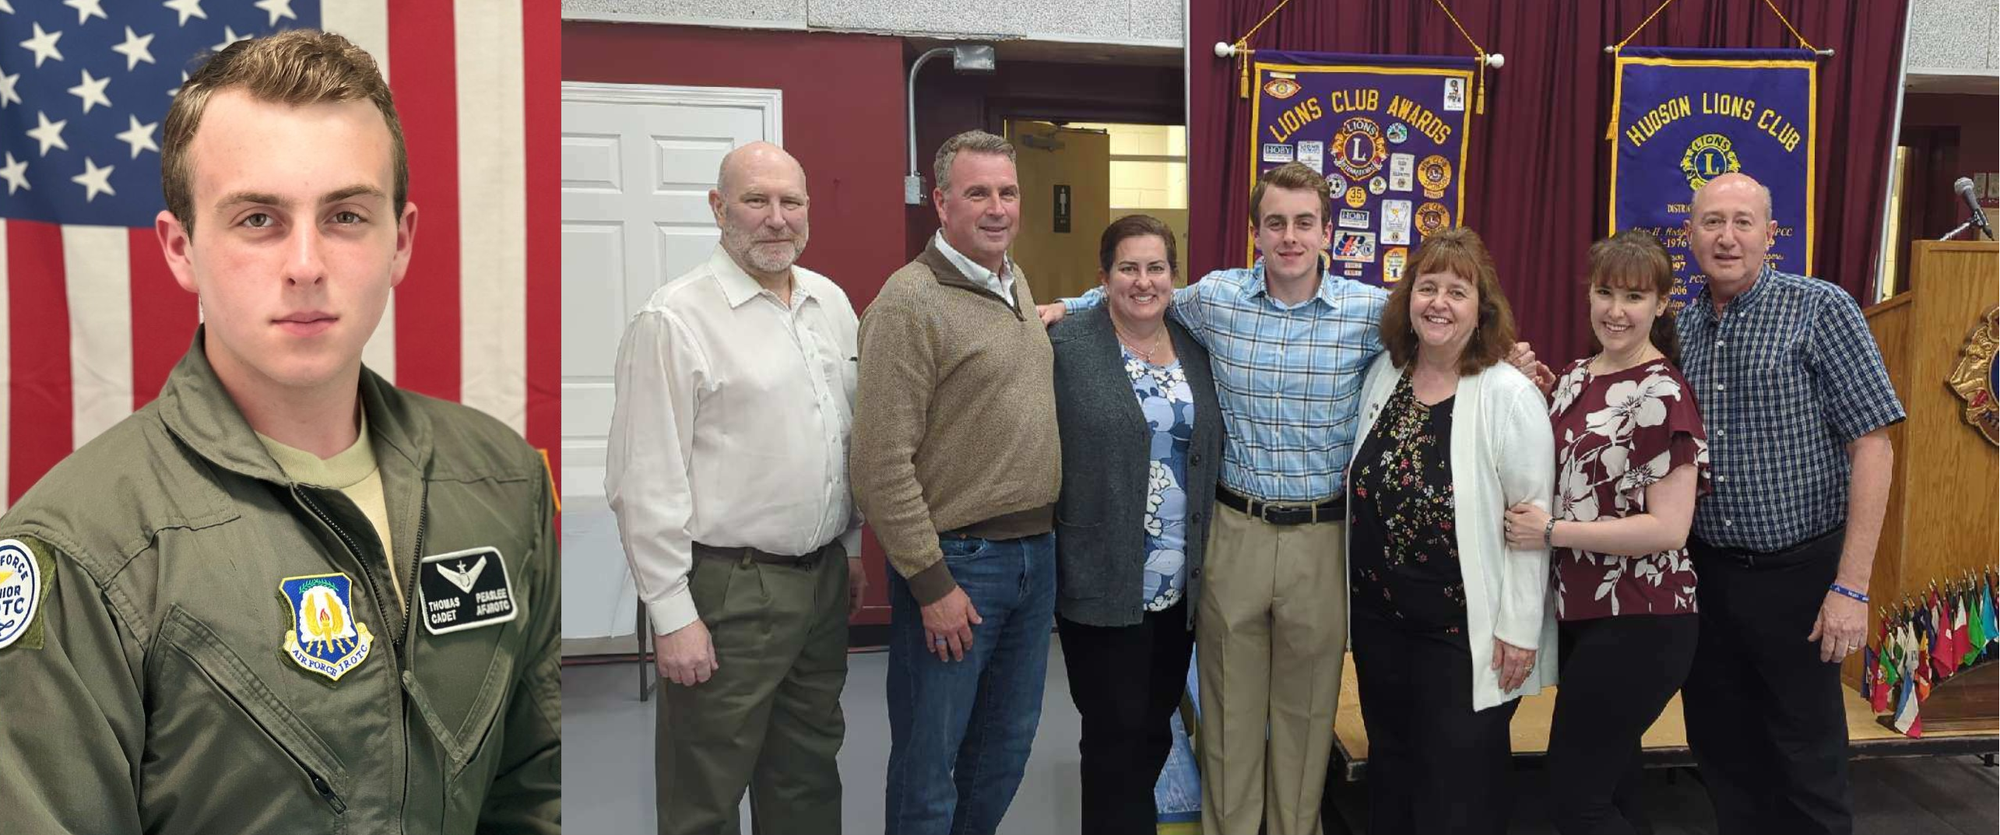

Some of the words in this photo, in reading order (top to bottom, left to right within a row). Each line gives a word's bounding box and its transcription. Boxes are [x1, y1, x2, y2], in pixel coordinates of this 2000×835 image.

[1269, 97, 1322, 143] LIONS
[1331, 89, 1379, 114] CLUB
[1387, 95, 1451, 145] AWARDS
[1626, 95, 1692, 147] HUDSON
[1702, 92, 1756, 121] LIONS
[1757, 109, 1801, 152] CLUB
[1346, 120, 1377, 136] LIONS
[1352, 138, 1366, 162] L
[1695, 135, 1731, 150] LIONS
[1704, 153, 1720, 176] L
[1350, 188, 1362, 199] 35
[1775, 227, 1793, 237] PCC
[1662, 238, 1687, 248] -1976
[0, 553, 29, 582] FORCE
[428, 596, 461, 612] THOMAS
[475, 588, 508, 604] PEASLEE
[0, 597, 25, 616] TC
[431, 609, 457, 624] CADET
[292, 649, 309, 666] AIR
[308, 659, 338, 677] FORCE
